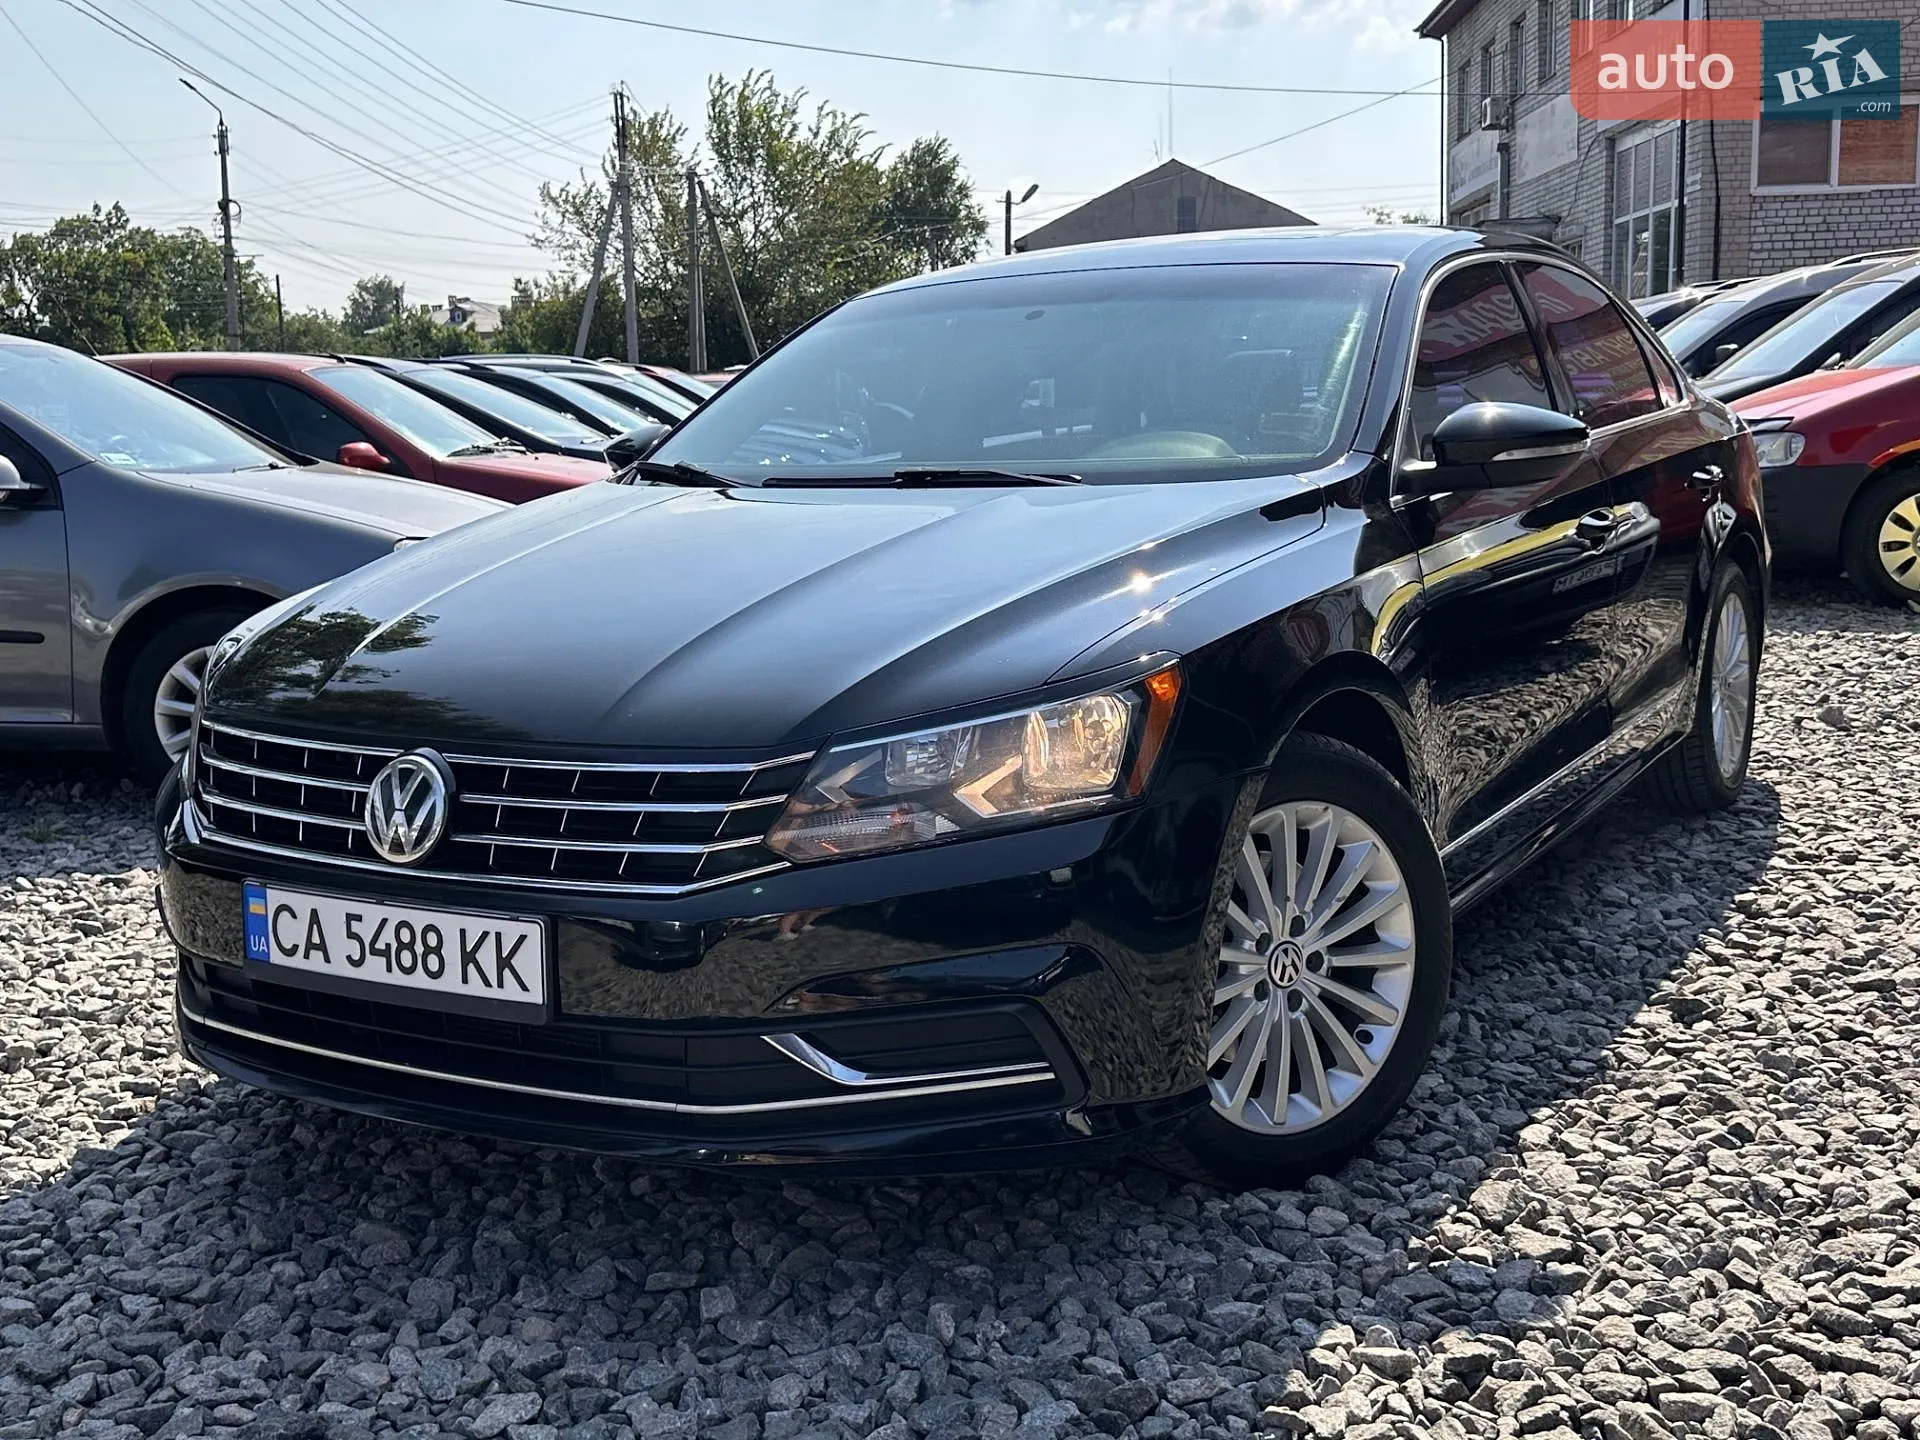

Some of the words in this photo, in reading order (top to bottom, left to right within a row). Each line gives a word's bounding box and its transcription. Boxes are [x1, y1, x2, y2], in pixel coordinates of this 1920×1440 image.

[250, 934, 268, 953] UA
[272, 903, 332, 964] CA
[344, 912, 446, 980] 5488
[459, 927, 531, 993] KK
